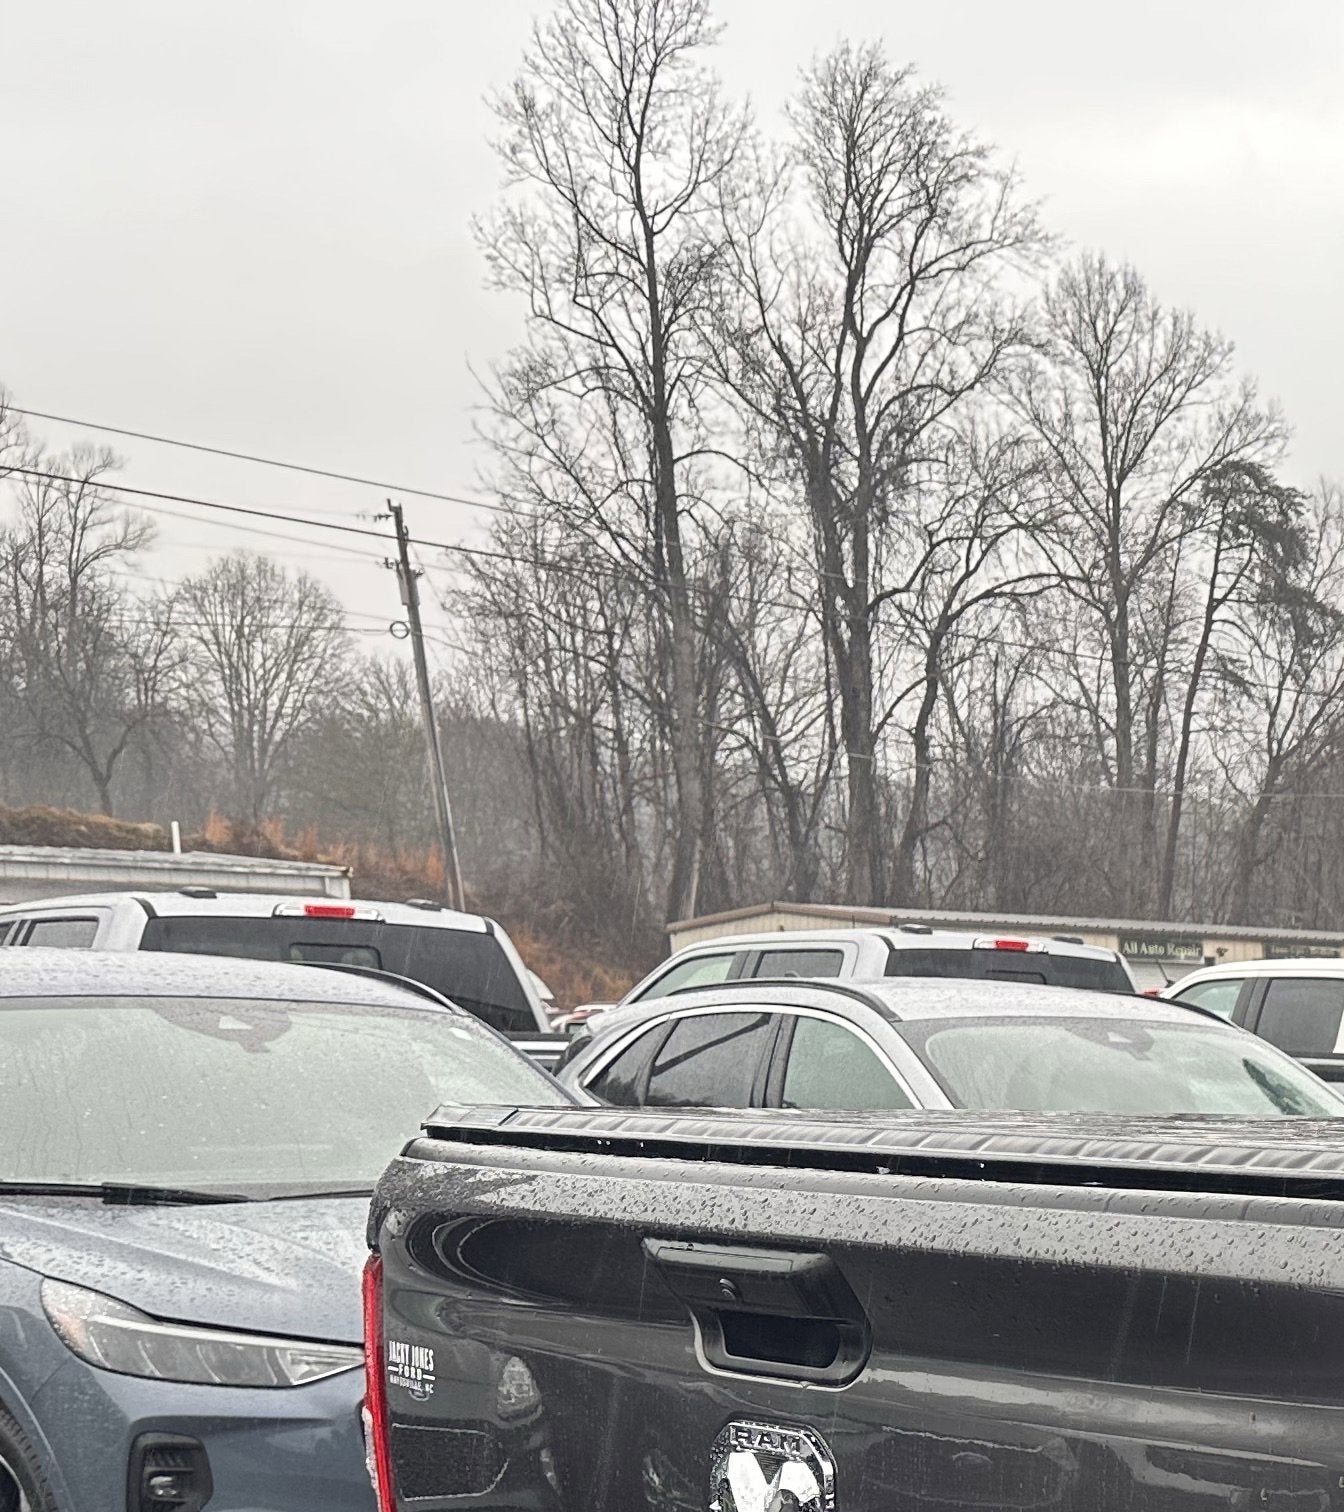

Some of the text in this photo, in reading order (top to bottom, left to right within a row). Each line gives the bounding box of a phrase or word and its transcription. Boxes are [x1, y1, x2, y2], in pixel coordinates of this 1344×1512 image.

[1123, 940, 1201, 960] All Auto Repair
[388, 1340, 434, 1372] JACKY JONES
[398, 1363, 423, 1381] FORD
[734, 1427, 802, 1456] RAM
